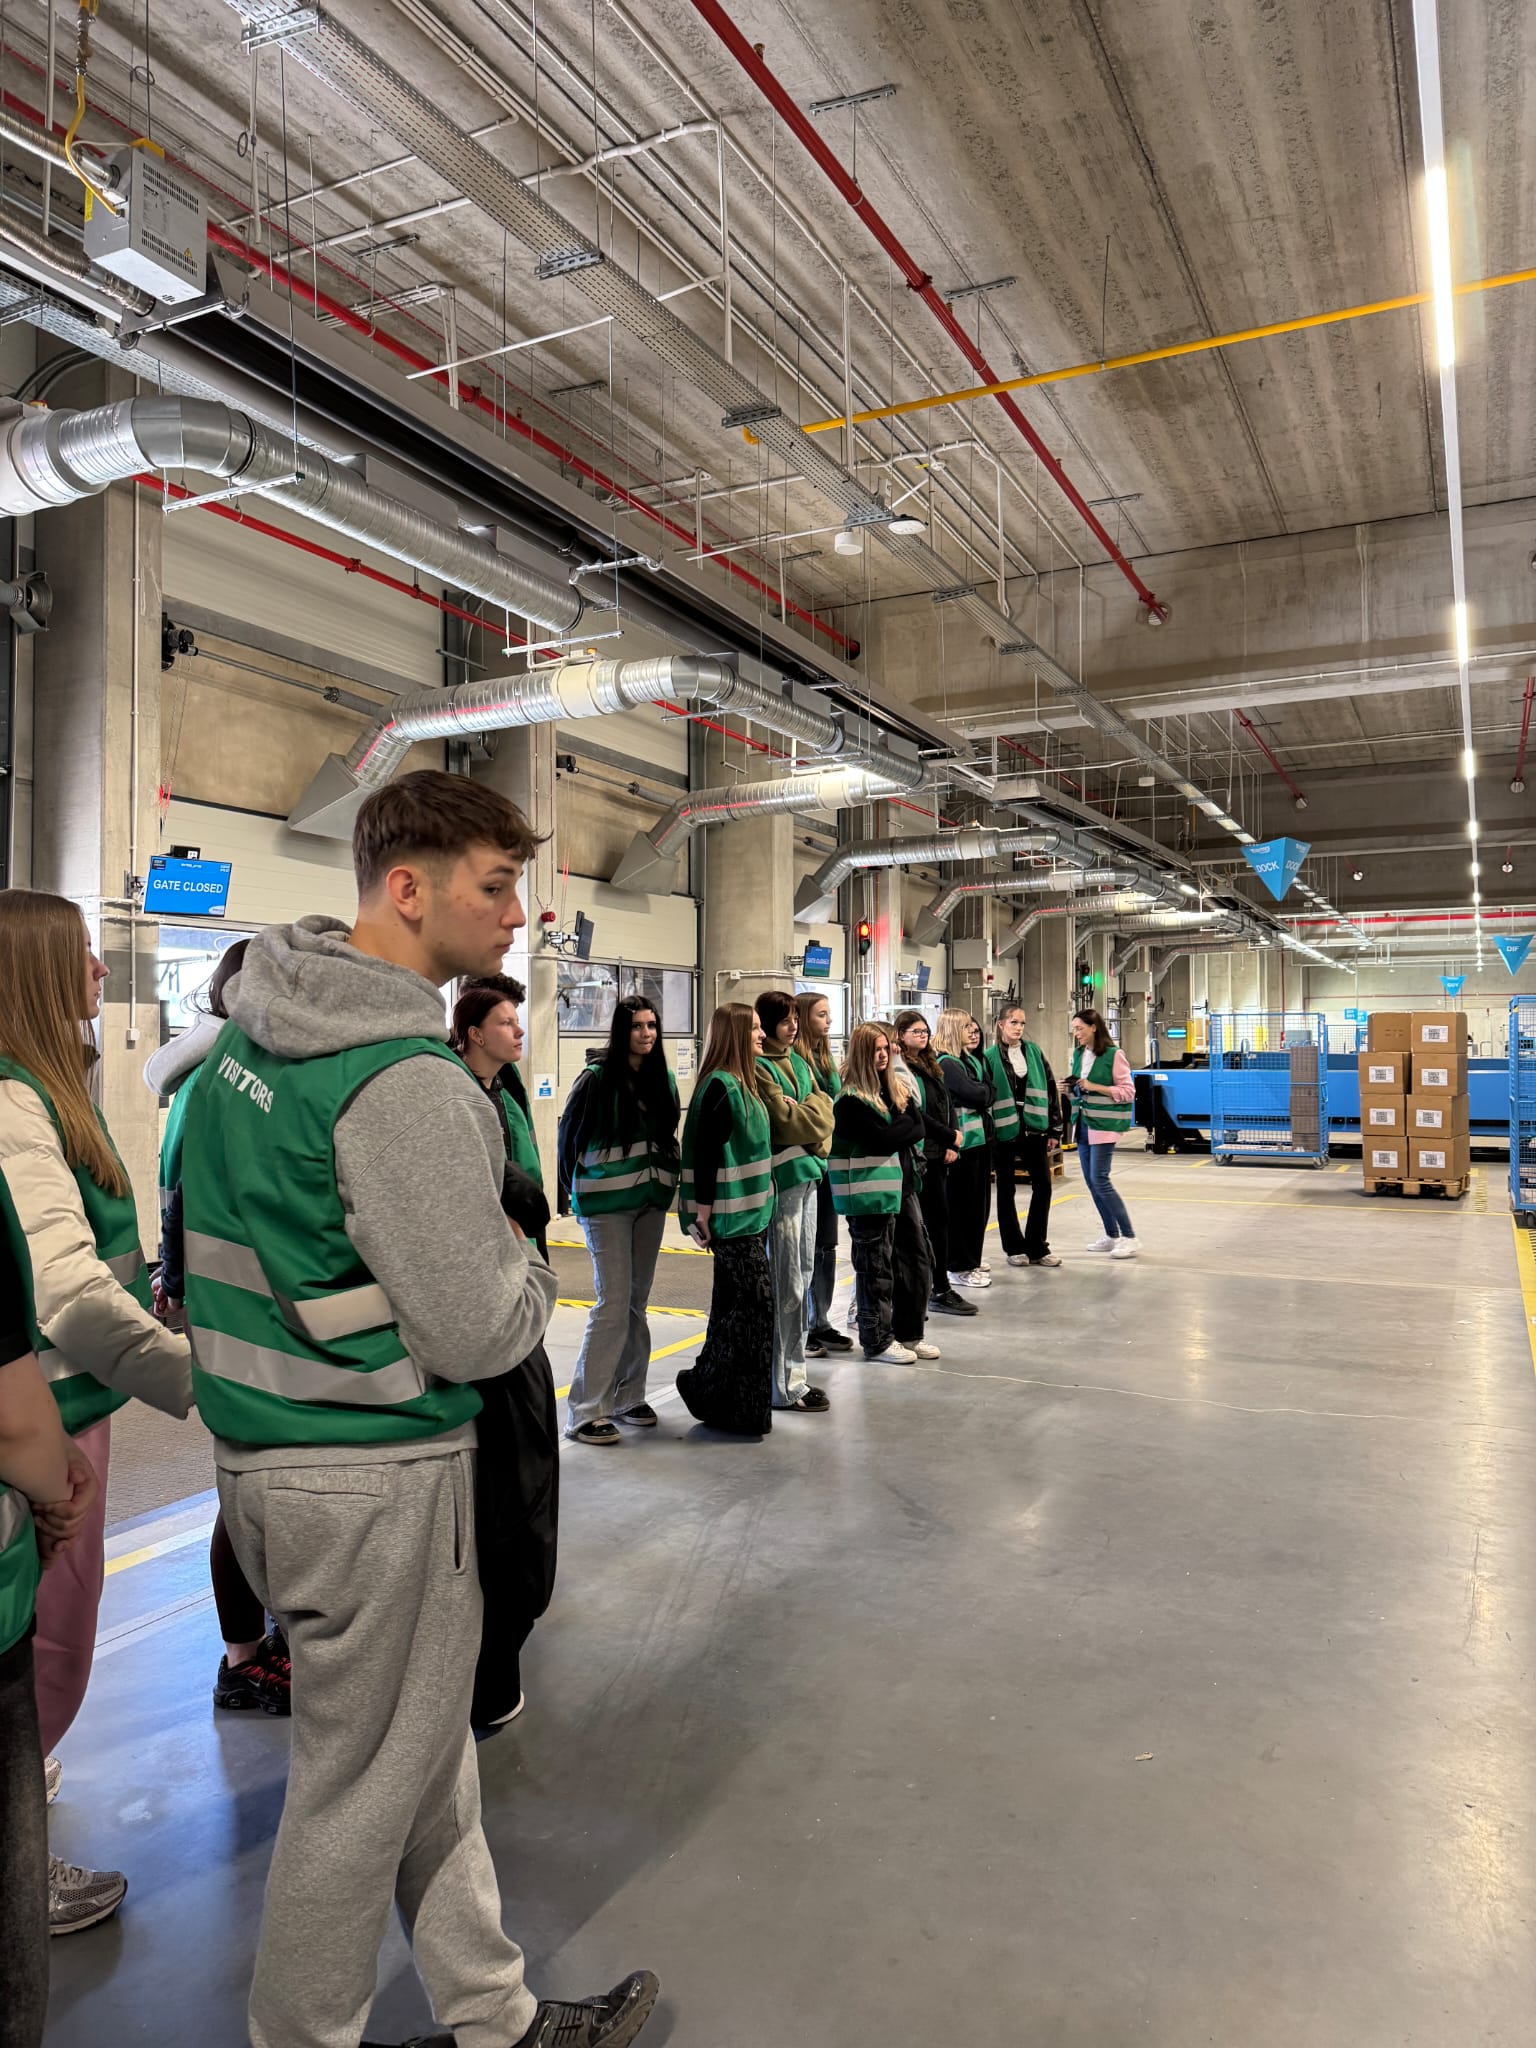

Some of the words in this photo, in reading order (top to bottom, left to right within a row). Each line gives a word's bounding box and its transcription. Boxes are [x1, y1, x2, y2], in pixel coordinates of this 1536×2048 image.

[1255, 861, 1279, 872] DOCK
[153, 880, 181, 891] GATE
[183, 882, 223, 893] CLOSED
[217, 1052, 274, 1113] VISITORS
